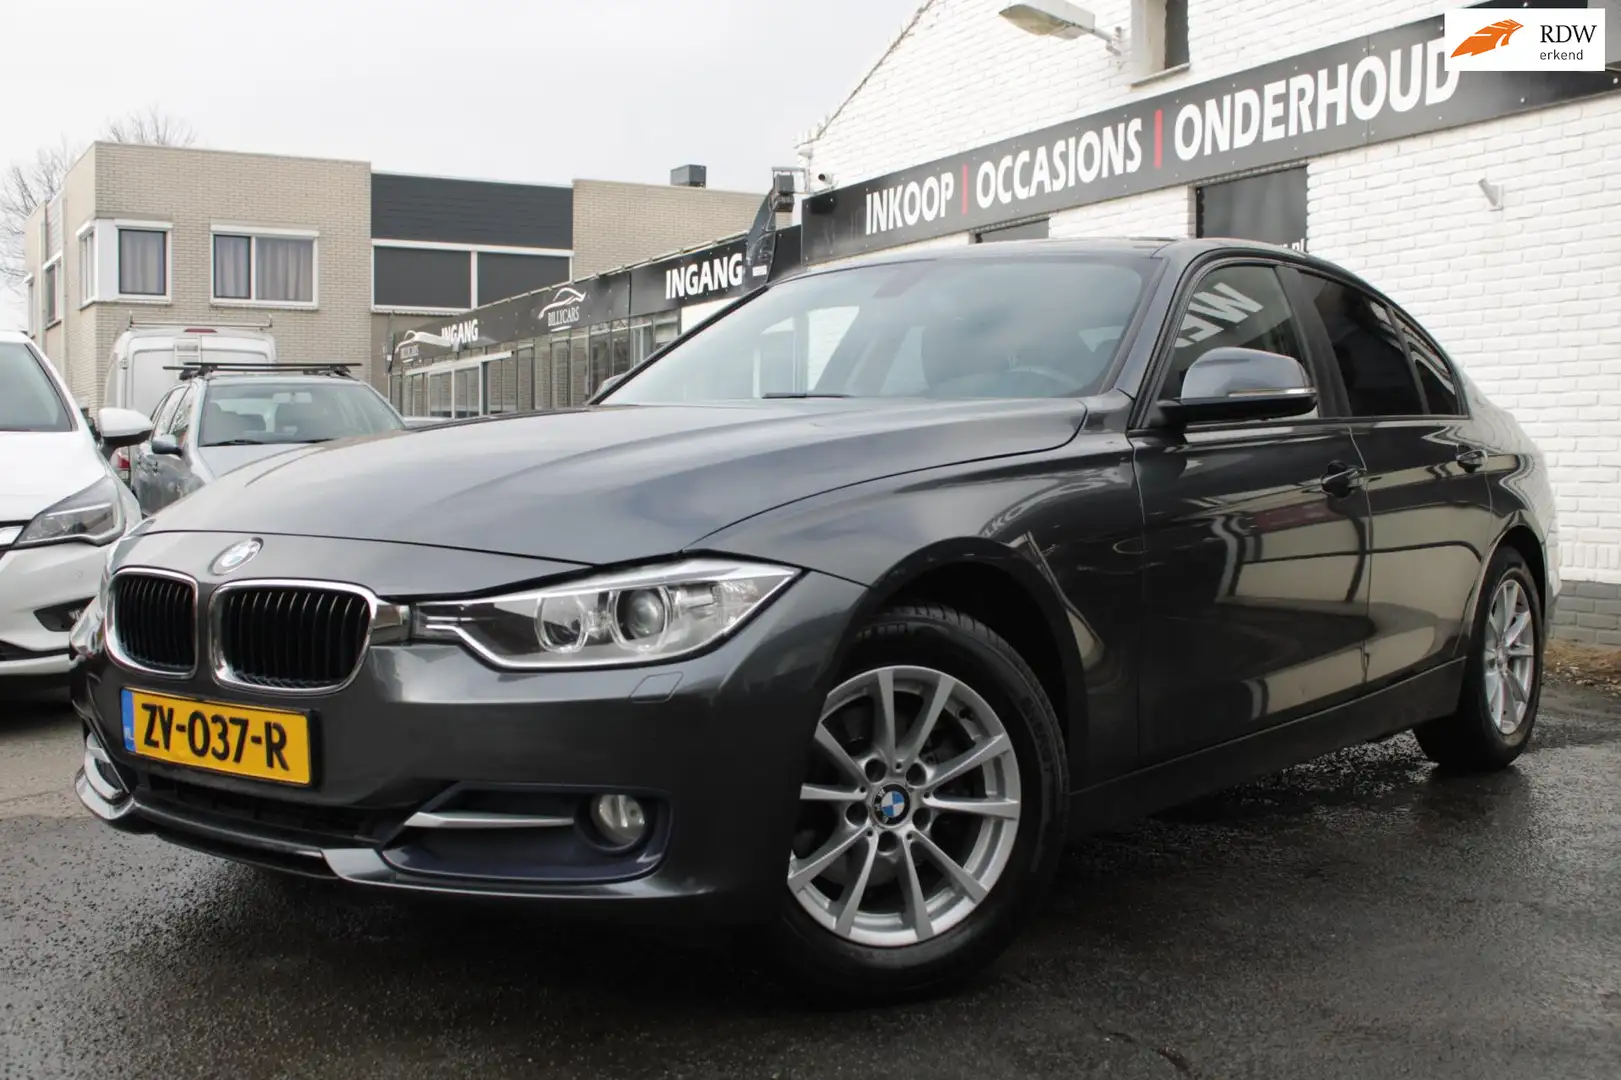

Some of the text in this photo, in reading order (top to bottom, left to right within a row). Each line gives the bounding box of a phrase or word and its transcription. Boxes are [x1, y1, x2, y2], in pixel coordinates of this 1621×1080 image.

[865, 40, 1460, 236] INKOOP OCCASIONS ONDERHOUD
[665, 252, 743, 300] INGANG
[441, 318, 479, 344] INGANG
